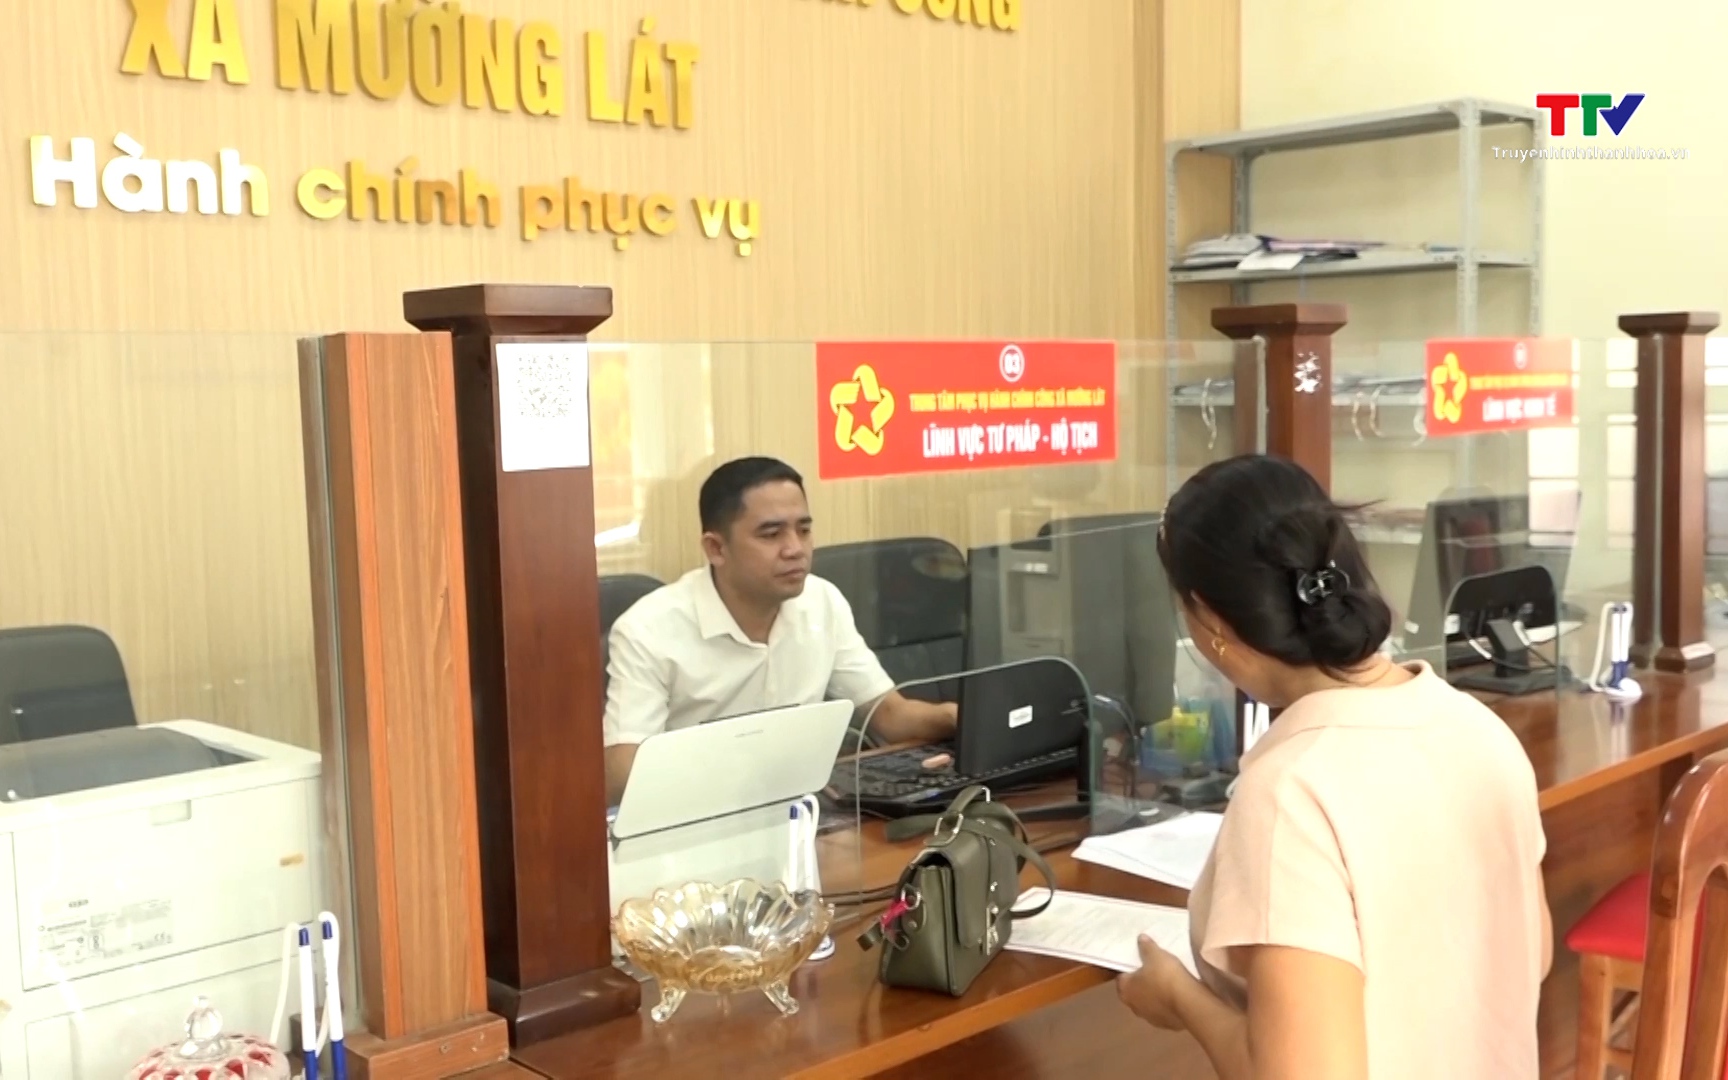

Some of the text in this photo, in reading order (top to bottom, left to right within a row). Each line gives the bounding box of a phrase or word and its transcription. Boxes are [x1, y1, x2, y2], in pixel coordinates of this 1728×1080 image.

[586, 16, 699, 129] LÁT
[30, 132, 762, 257] Hành chính phục vụ
[922, 422, 955, 458] LĨNH
[957, 423, 985, 461] VỰC
[986, 422, 1006, 454] TƯ
[1005, 418, 1041, 452] PHÁP
[1050, 417, 1069, 456] HỘ
[1070, 421, 1098, 455] TỊCH
